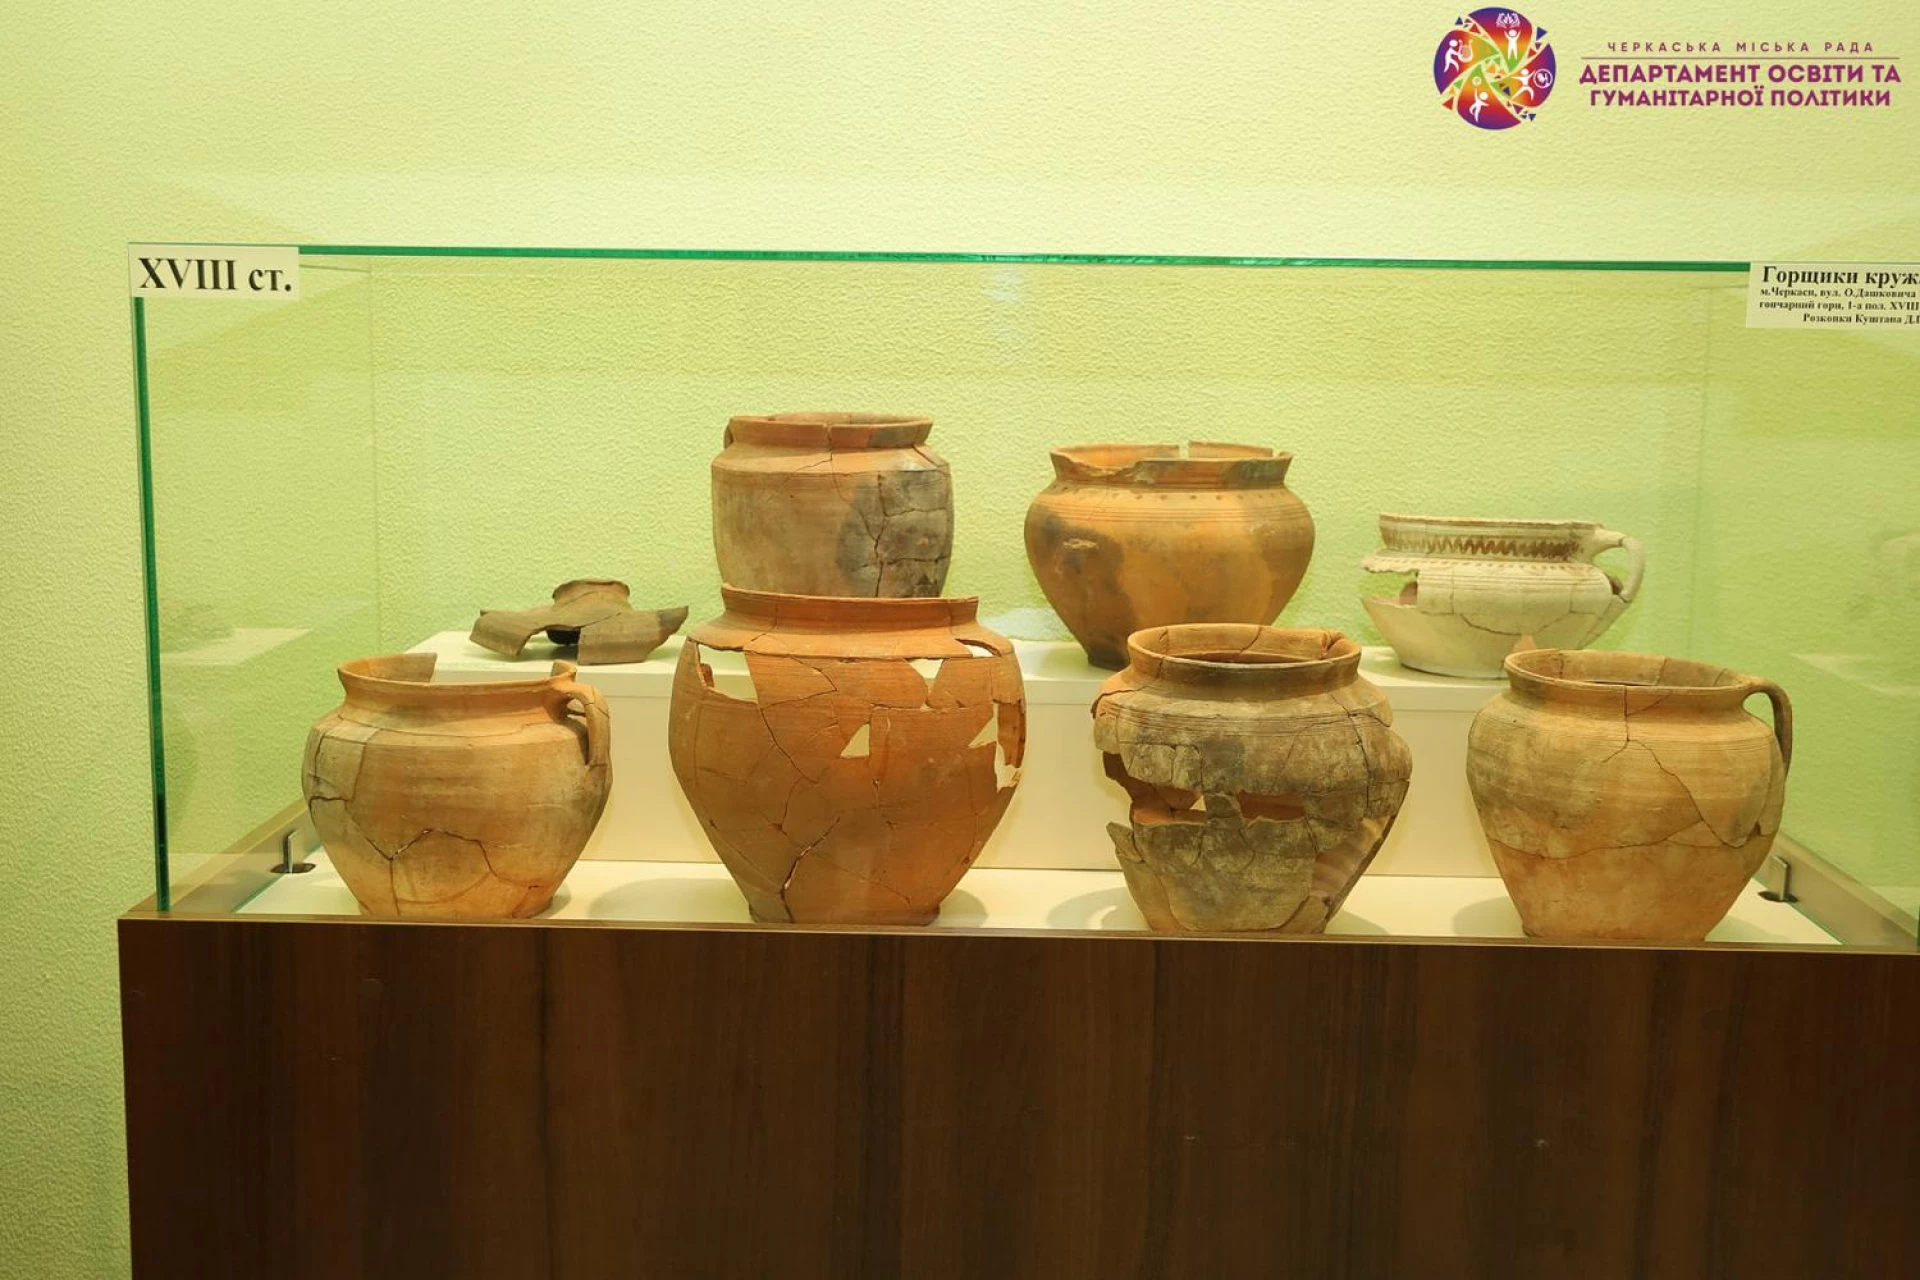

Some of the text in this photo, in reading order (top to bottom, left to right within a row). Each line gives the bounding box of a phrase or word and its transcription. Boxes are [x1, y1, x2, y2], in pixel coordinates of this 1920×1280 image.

[138, 258, 292, 291] XVIII ст.
[1763, 266, 1920, 288] Горщики круж
[1820, 290, 1841, 298] вул.
[1817, 303, 1844, 311] горн,
[1890, 302, 1919, 310] XVIII
[1803, 313, 1852, 323] Розкопки
[1855, 314, 1901, 325] Куштана
